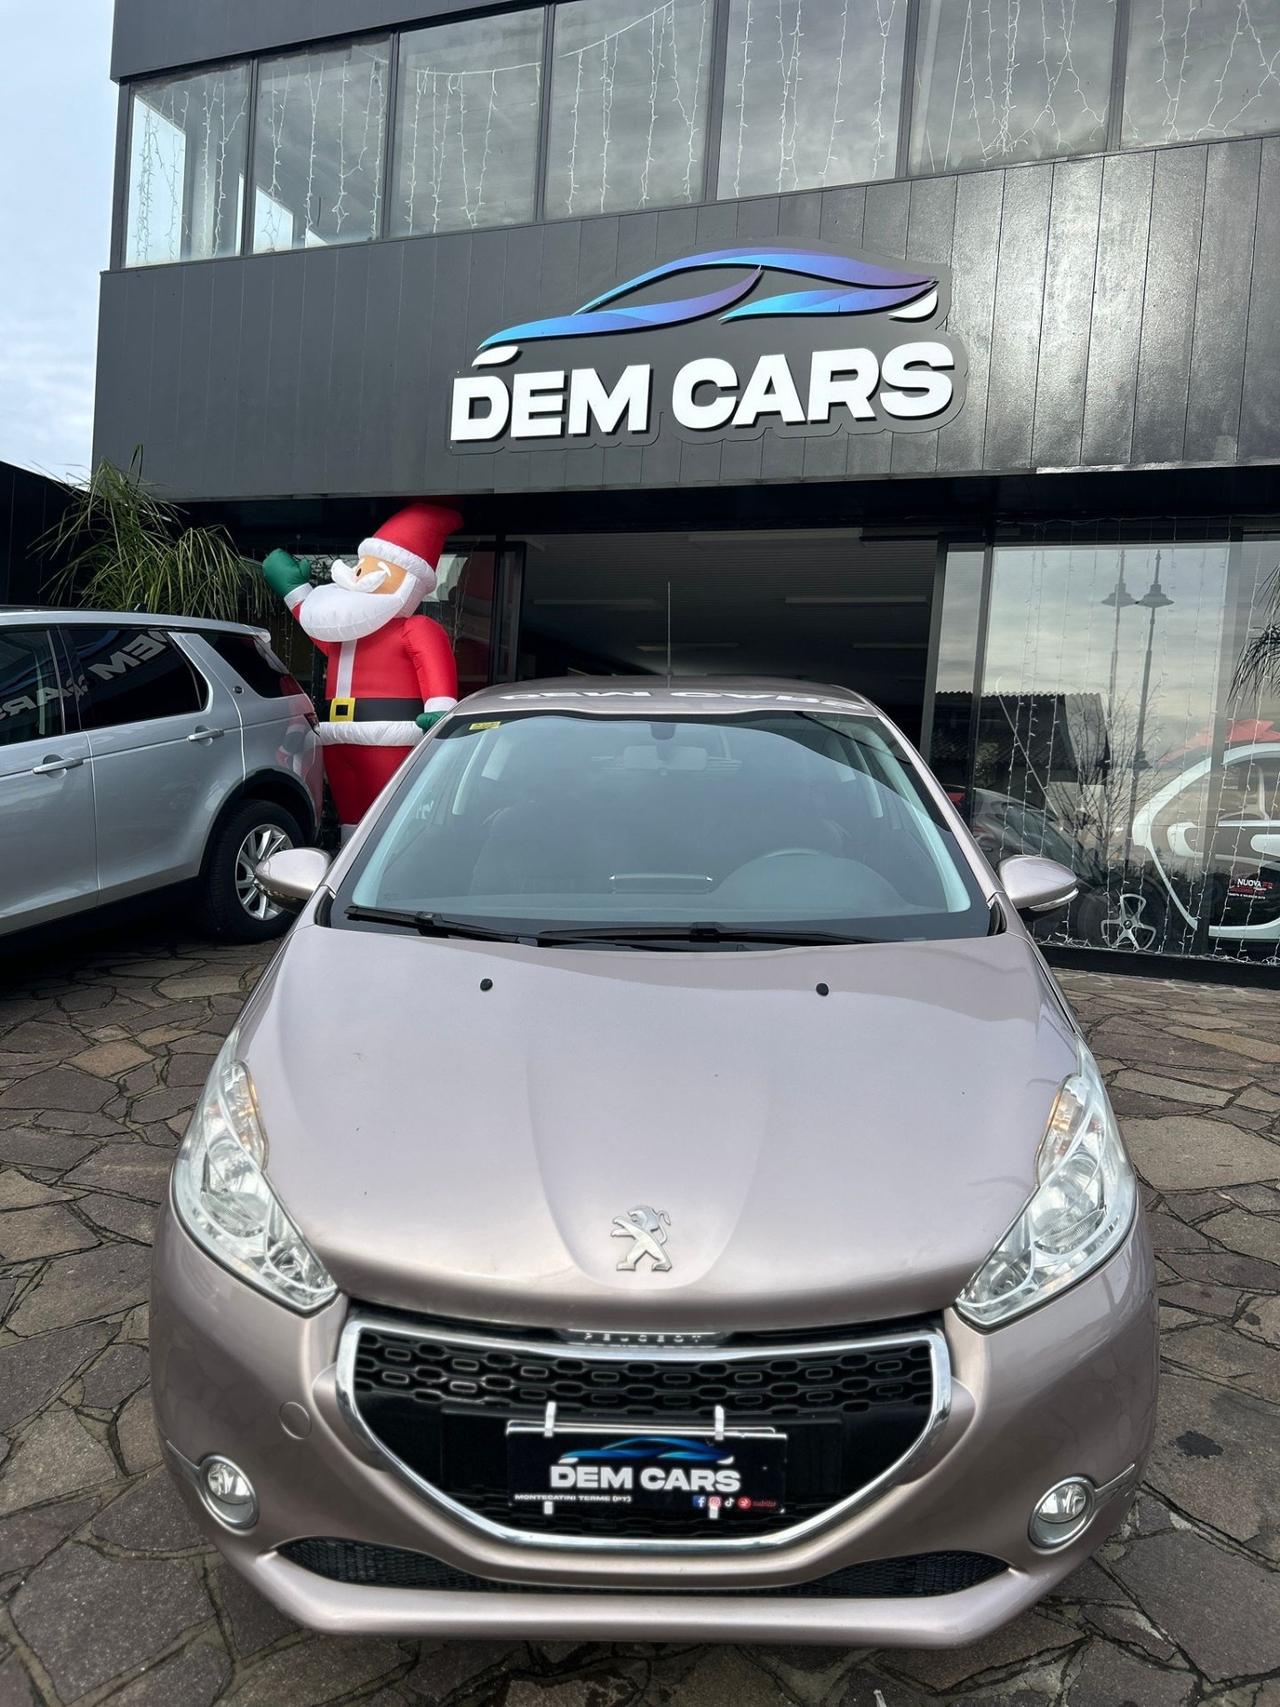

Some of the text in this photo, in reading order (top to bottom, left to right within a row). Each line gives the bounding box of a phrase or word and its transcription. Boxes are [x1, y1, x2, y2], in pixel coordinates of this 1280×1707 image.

[450, 341, 956, 442] DEM CARS
[550, 1465, 741, 1492] DEM CARS
[514, 1493, 577, 1502] MONTECATINI
[578, 1494, 611, 1502] TERME
